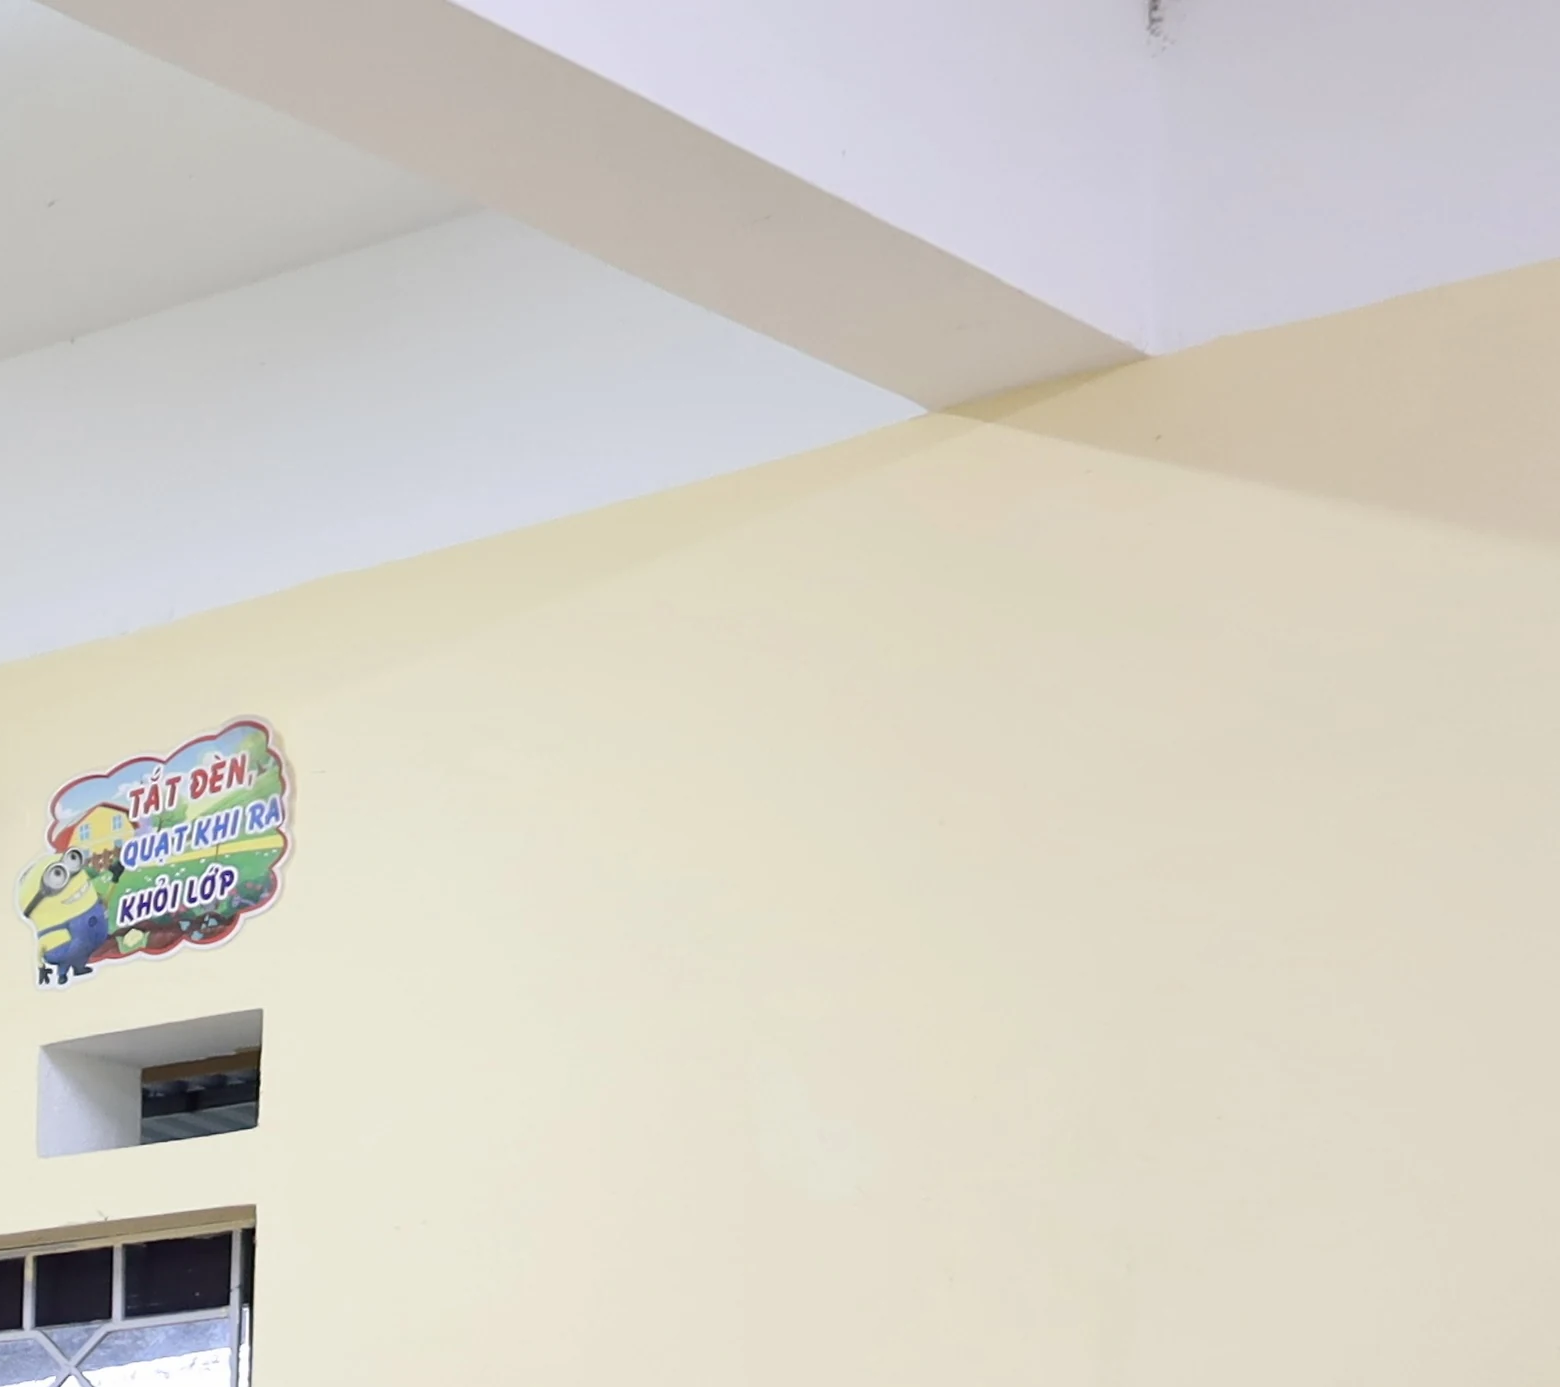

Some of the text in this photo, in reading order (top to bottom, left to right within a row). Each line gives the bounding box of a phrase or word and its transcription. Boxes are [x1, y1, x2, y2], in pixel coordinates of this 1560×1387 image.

[129, 767, 181, 819] TẮT
[123, 798, 280, 866] QUẠT KHI RA
[120, 867, 235, 924] KHỎI LỚP
